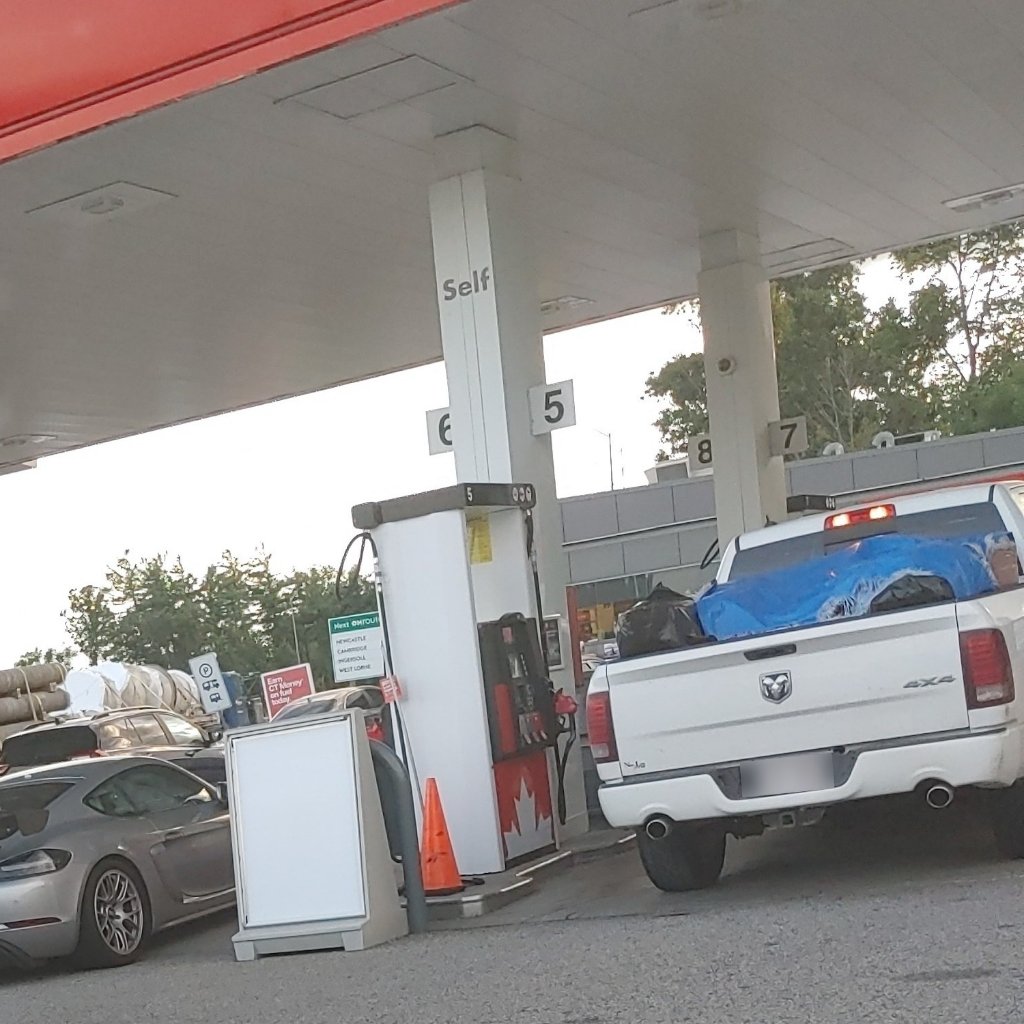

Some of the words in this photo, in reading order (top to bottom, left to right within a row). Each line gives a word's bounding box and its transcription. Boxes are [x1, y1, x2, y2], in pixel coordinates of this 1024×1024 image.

[443, 267, 490, 301] Self
[543, 389, 565, 424] 5
[438, 413, 453, 446] 6
[780, 423, 798, 449] 7
[697, 439, 713, 464] 8
[467, 487, 474, 502] 5
[334, 621, 350, 630] Next
[337, 645, 367, 655] CAMBRIDGE
[267, 677, 283, 685] Earn
[269, 684, 279, 692] CT
[279, 678, 304, 689] Money
[279, 688, 293, 697] fuel
